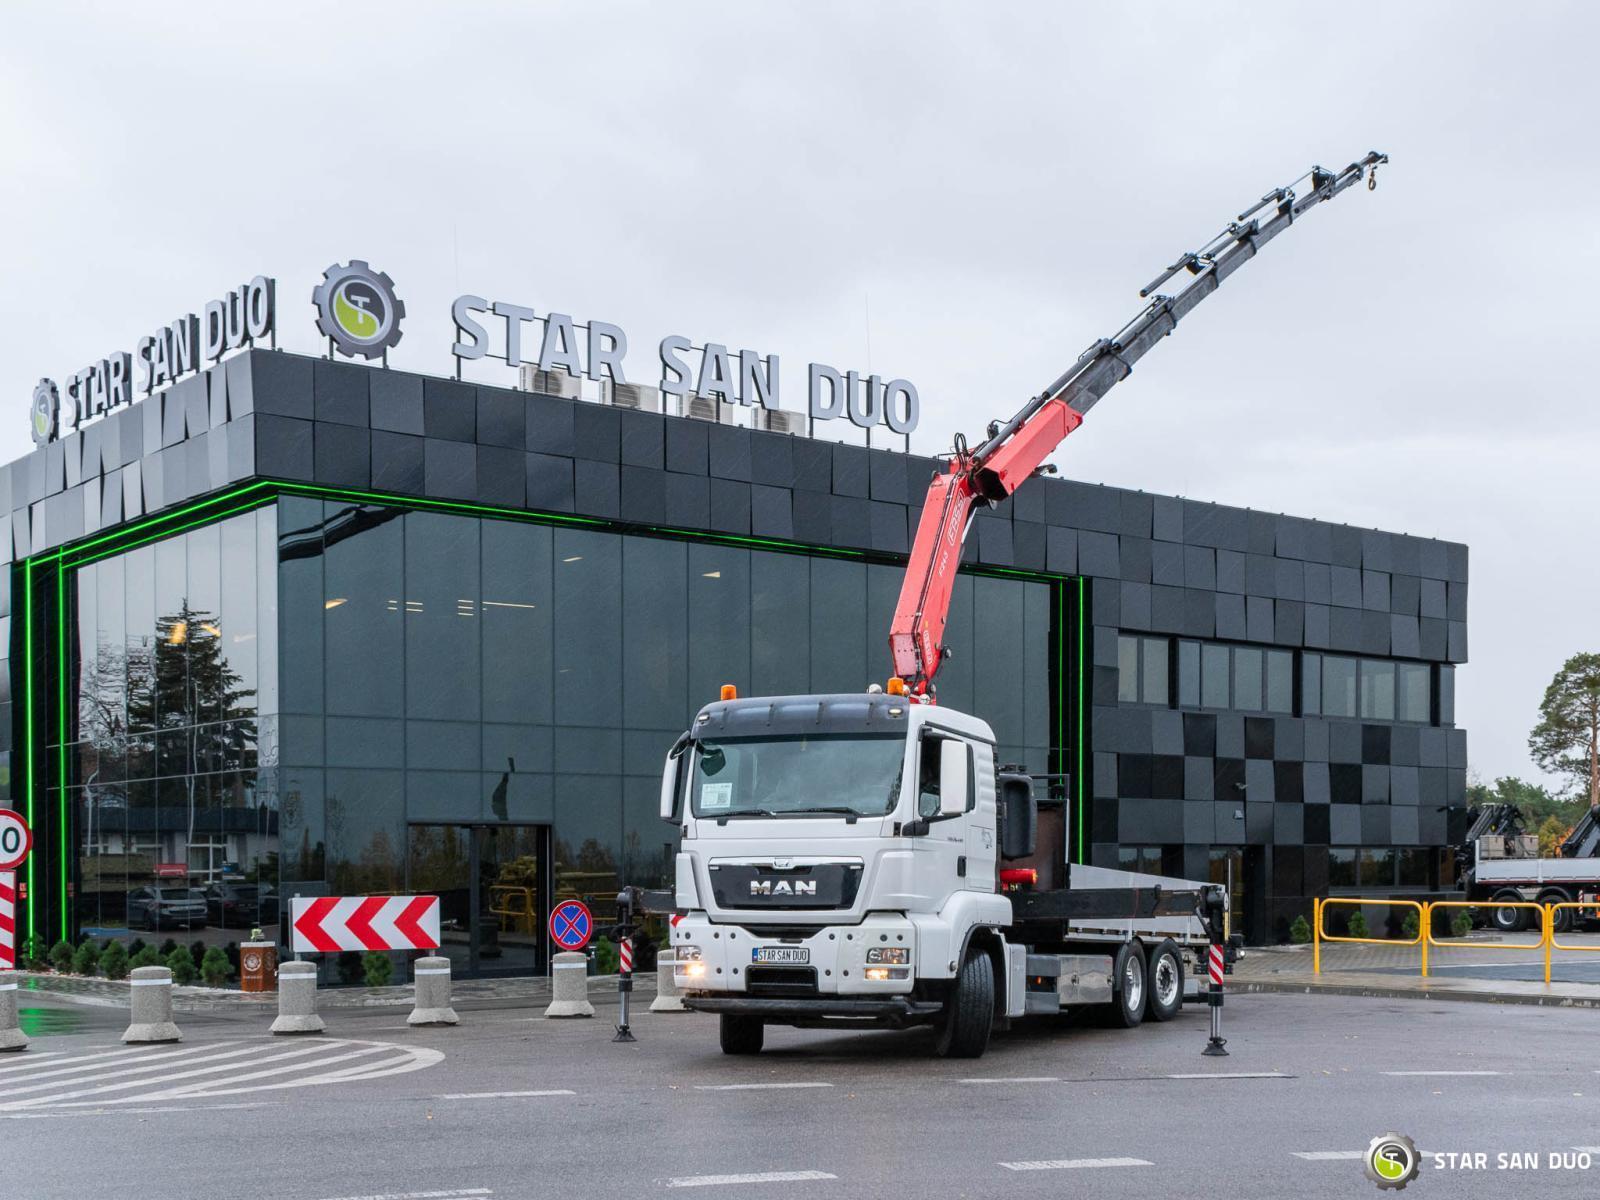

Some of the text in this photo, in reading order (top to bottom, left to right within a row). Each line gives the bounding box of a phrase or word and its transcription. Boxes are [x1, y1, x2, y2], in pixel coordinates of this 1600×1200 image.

[65, 275, 271, 428] STAR SAN DUO
[451, 295, 920, 434] STAR SAN DUO
[750, 880, 817, 896] MAN
[758, 950, 807, 961] STAR SAN DUO
